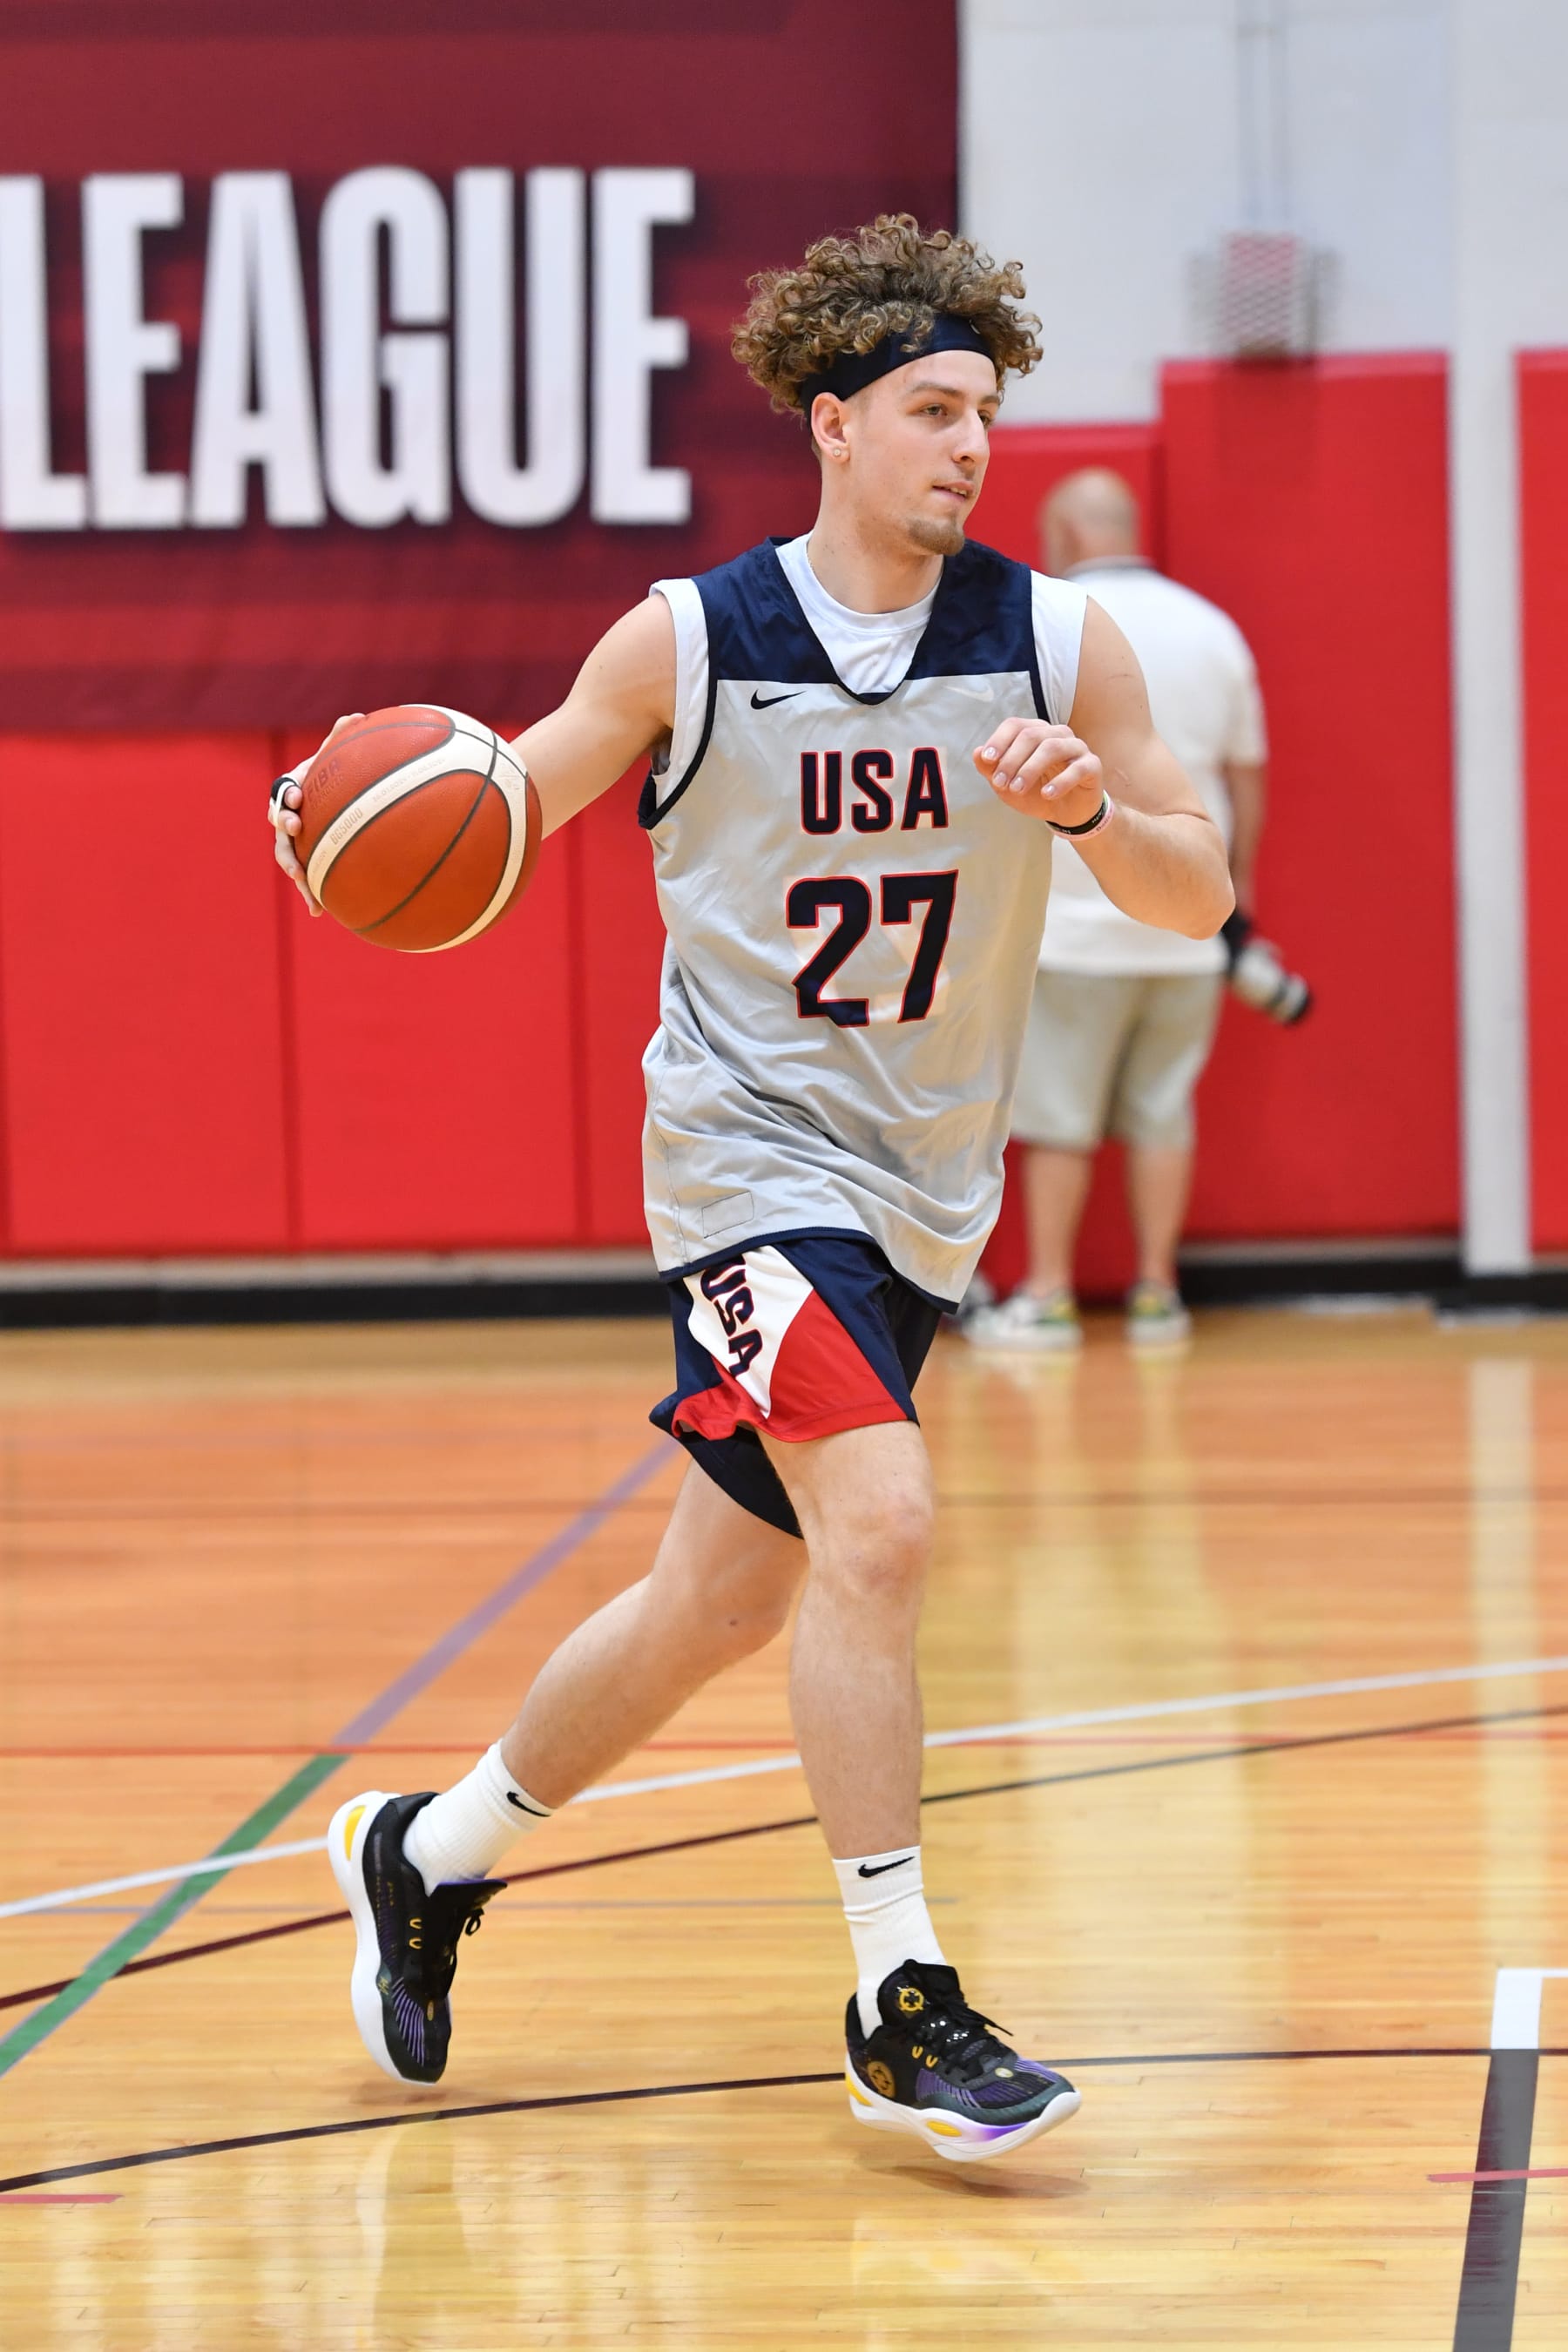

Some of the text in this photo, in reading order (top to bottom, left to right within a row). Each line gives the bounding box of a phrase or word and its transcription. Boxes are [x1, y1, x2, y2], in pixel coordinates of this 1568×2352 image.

[0, 166, 695, 529] LEAGUE
[307, 759, 341, 802] FIBA
[800, 747, 949, 836] USA
[786, 868, 959, 1028] 27
[700, 1254, 763, 1377] USA
